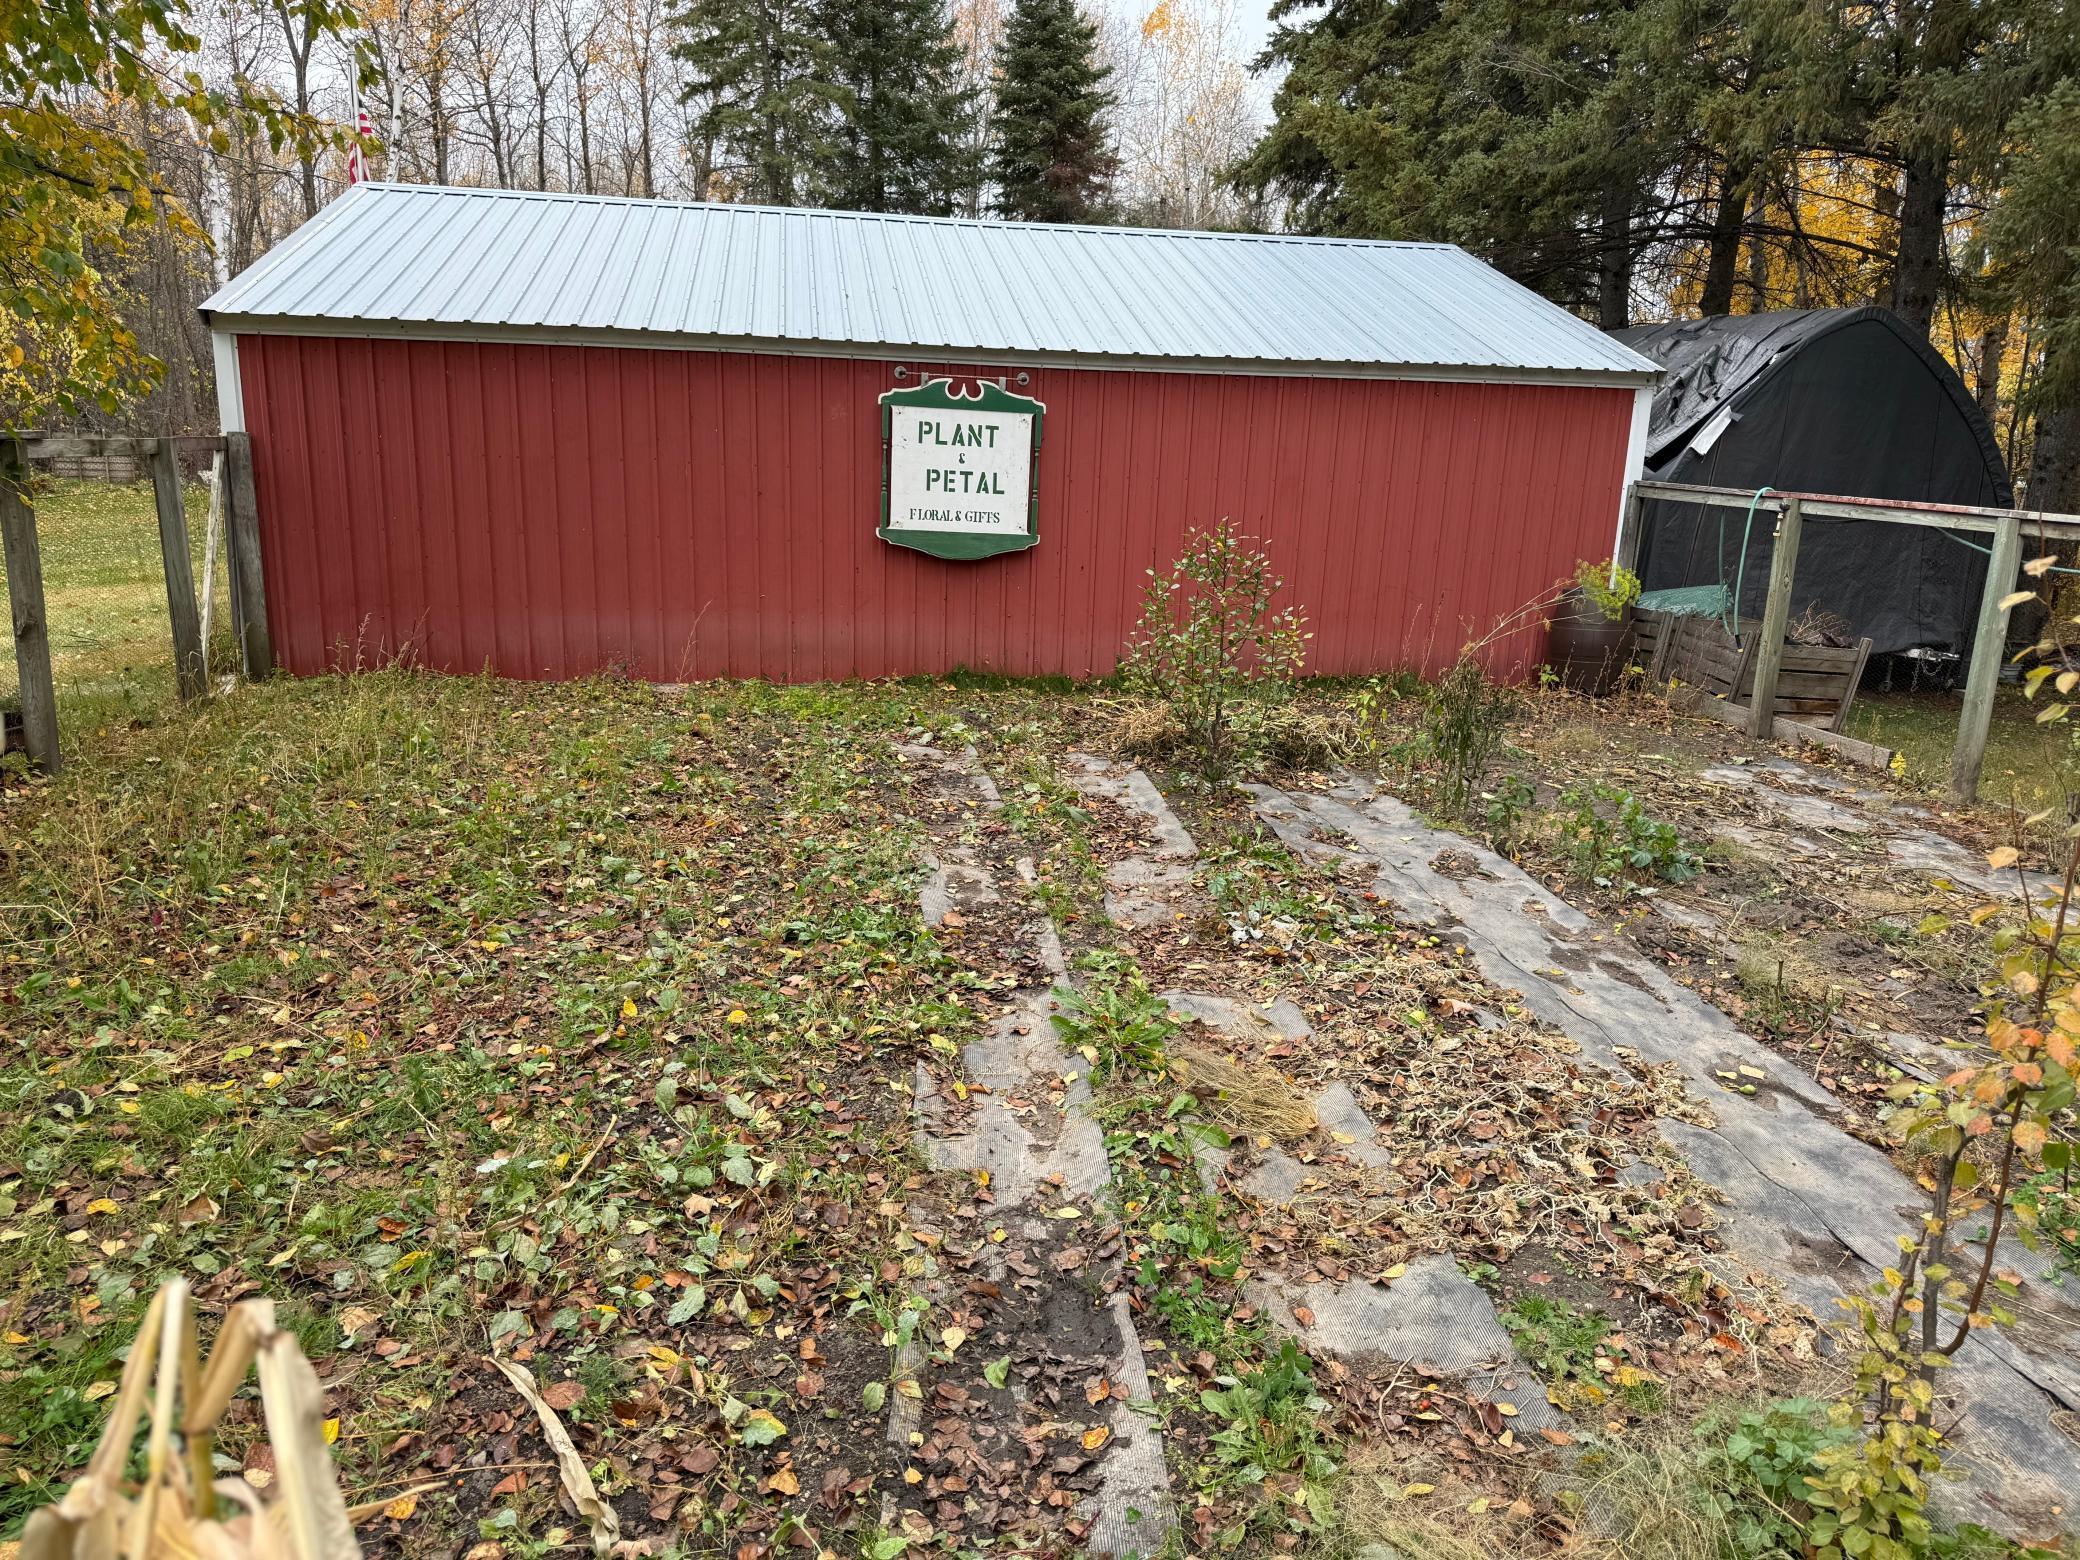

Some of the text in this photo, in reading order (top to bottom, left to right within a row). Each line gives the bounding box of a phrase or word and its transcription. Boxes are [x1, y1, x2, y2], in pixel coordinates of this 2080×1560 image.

[918, 421, 1000, 448] PLANT
[958, 452, 966, 464] &
[926, 468, 1005, 495] PETAL
[909, 508, 1000, 524] FLORAL & GIFTS
